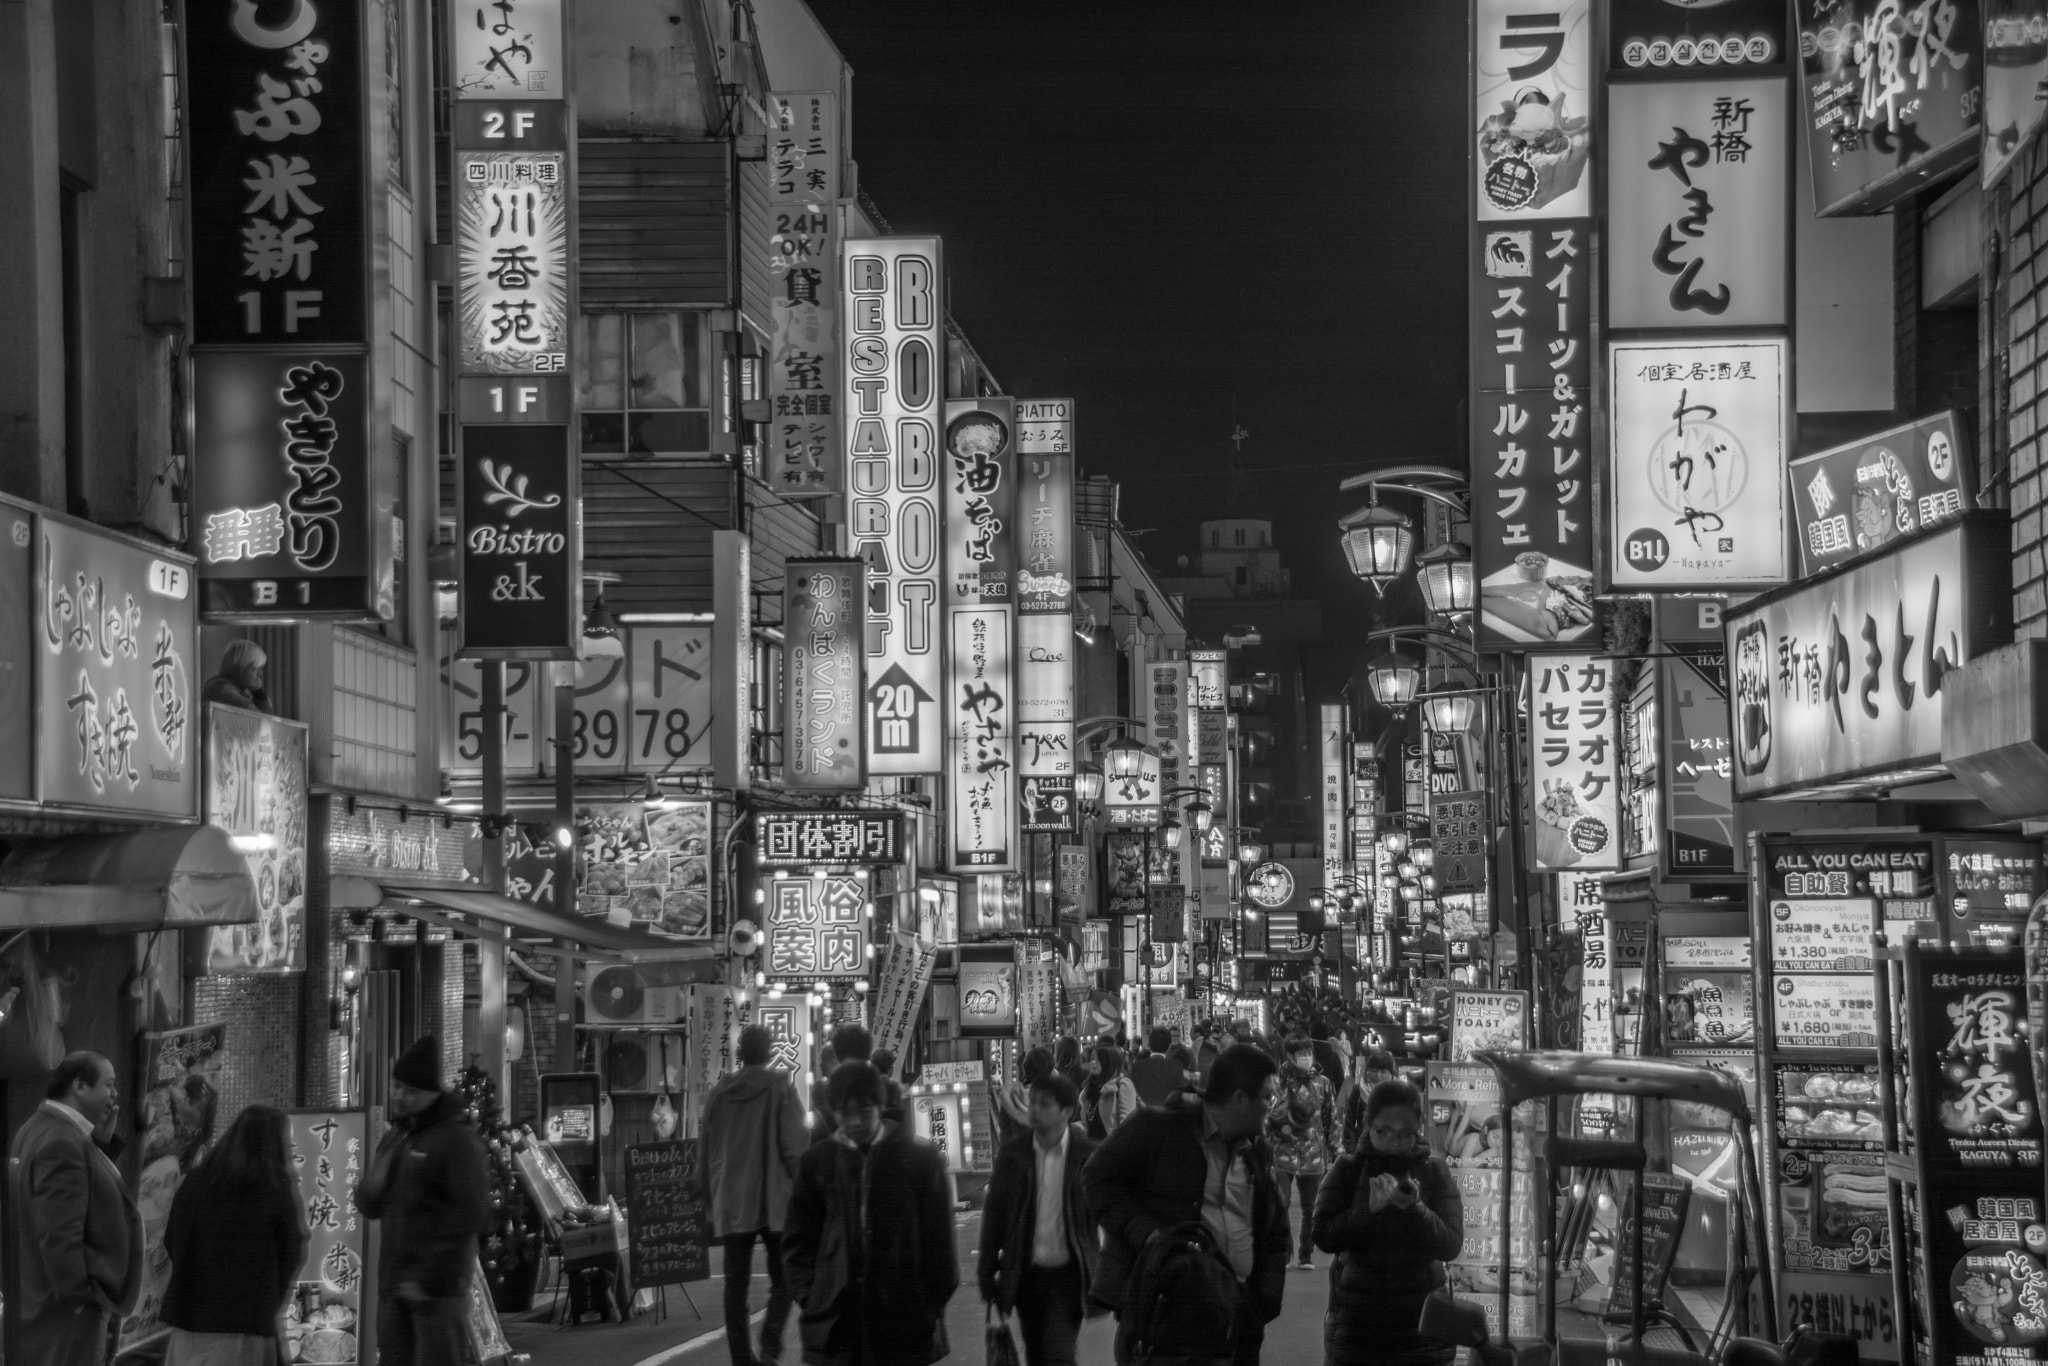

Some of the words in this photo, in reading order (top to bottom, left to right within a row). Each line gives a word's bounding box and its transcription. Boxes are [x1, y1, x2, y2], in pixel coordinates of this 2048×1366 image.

[1625, 39, 1767, 63] 삼겹살전문점
[1960, 86, 1981, 119] 3F
[484, 111, 536, 139] 2F
[1709, 97, 1755, 165] 新橋
[469, 163, 556, 181] 四川料理
[776, 138, 796, 195] テラコ
[806, 137, 828, 191] 三実
[1502, 162, 1528, 179] 名物
[776, 213, 829, 235] 24H
[1647, 126, 1731, 316] やきとん
[780, 237, 827, 257] OK!
[488, 191, 540, 346] 川香苑
[239, 290, 323, 334] 1F
[534, 354, 566, 372] 2F
[1636, 361, 1757, 382] 個室居酒屋
[1544, 229, 1584, 545] スイーツ&ガレット
[488, 386, 540, 413] 1F
[776, 393, 832, 417] 完全個室
[1016, 403, 1066, 418] PIATTO
[1491, 287, 1533, 546] スコールカフェ
[782, 423, 803, 483] テレビ有
[807, 422, 828, 483] シャワー有
[850, 254, 892, 658] RESTAURANT
[895, 254, 935, 656] ROBOT
[1053, 443, 1069, 452] 5F
[1931, 442, 1949, 471] 2F
[279, 360, 345, 573] やきとり
[1668, 387, 1727, 551] わがや
[954, 452, 1002, 563] 油そば
[1030, 460, 1056, 573] リーチ麻雀
[468, 523, 566, 555] Bistro
[1629, 541, 1653, 560] B1
[160, 564, 180, 584] 1F
[491, 561, 546, 601] &k
[1035, 592, 1051, 601] 4F
[1822, 573, 1964, 735] やきとん
[809, 572, 837, 774] わんぱくランド
[1777, 635, 1823, 709] 新橋
[876, 684, 915, 718] 20
[1538, 663, 1571, 768] パセラ
[881, 718, 910, 747] m
[1576, 663, 1611, 802] カラオケ
[1055, 762, 1071, 771] 2F
[1431, 773, 1456, 792] DVD
[1053, 799, 1066, 809] 2F
[1435, 802, 1479, 820] 悪質な
[768, 819, 895, 858] 団体割引
[1435, 821, 1479, 839] 客引き
[582, 831, 658, 867] ホルモン
[971, 852, 997, 864] B1F
[1436, 840, 1480, 857] に注意
[1679, 849, 1708, 862] B1F
[1775, 854, 1810, 870] ALL
[1811, 854, 1848, 869] YOU
[1849, 853, 1887, 868] CAN
[1889, 852, 1929, 867] EAT
[1785, 872, 1848, 896] 自助餐
[770, 878, 865, 925] 風俗
[1774, 907, 1790, 918] 5F
[1793, 904, 1846, 914] Okonomiyaki
[1838, 912, 1870, 922] Monjya
[1775, 923, 1822, 934] お好み焼き
[1831, 923, 1870, 934] もんじゃ
[771, 925, 863, 972] 案内
[1778, 945, 1827, 959] ¥1,380
[1775, 961, 1788, 970] ALL
[1787, 961, 1801, 970] YOU
[1802, 961, 1820, 970] CAN
[1820, 961, 1836, 970] EAT
[1778, 981, 1793, 993] 4F
[1796, 979, 1849, 988] Shabu-shabu
[1838, 988, 1873, 997] Sukiyaki
[1456, 996, 1503, 1006] HONEY
[1456, 1018, 1501, 1028] TOAST
[1829, 1008, 1842, 1018] or
[1781, 1021, 1831, 1035] ¥1,680
[1777, 1037, 1791, 1046] ALL
[1790, 1037, 1804, 1046] YOU
[1805, 1037, 1824, 1046] CAN
[1824, 1037, 1839, 1046] EAT
[1946, 990, 2026, 1122] 輝夜
[1441, 1079, 1469, 1090] More
[1433, 1105, 1450, 1120] 5F
[1949, 1138, 1976, 1147] Tenku
[1977, 1138, 2007, 1147] Aurora
[2007, 1138, 2036, 1148] Dining
[1784, 1154, 1808, 1177] 2F
[1960, 1150, 2008, 1160] KAGUYA
[2017, 1150, 2040, 1160] 3F
[309, 1118, 340, 1230] すき焼
[1977, 1198, 2036, 1220] 韓国風
[1963, 1220, 2020, 1241] 居酒屋
[2028, 1230, 2044, 1242] 2F
